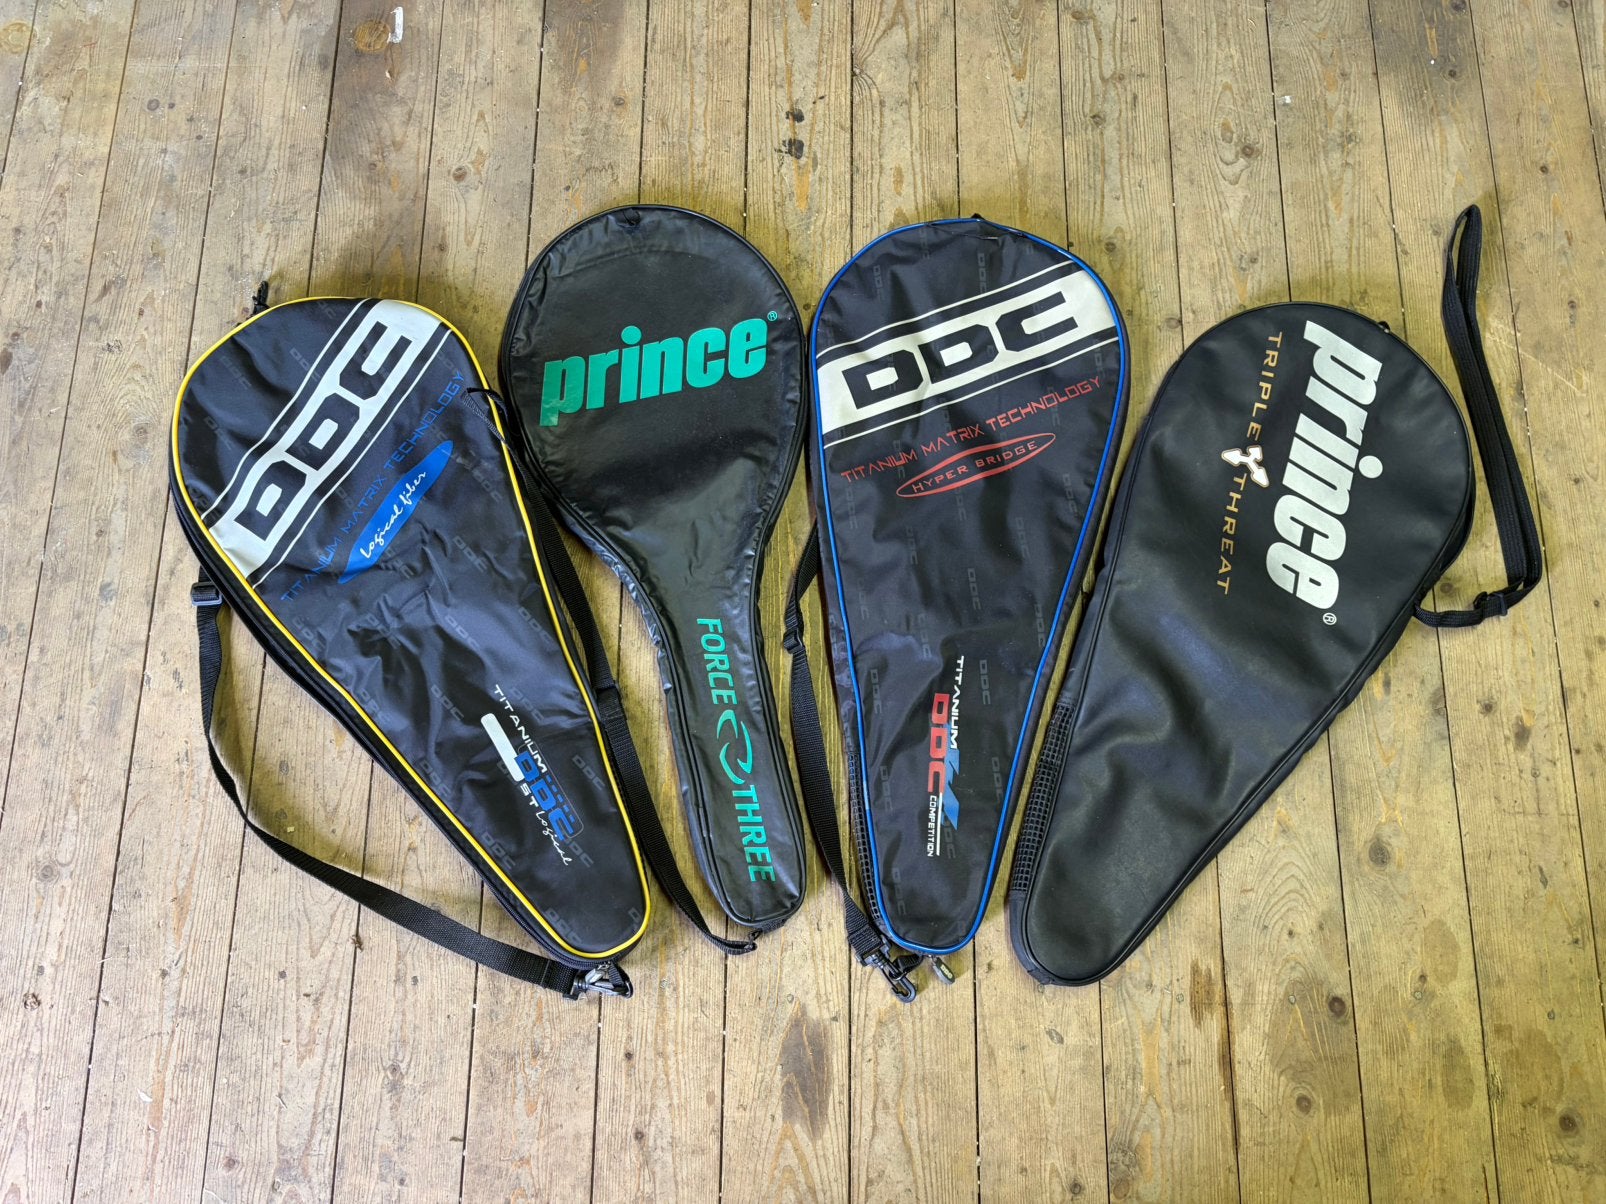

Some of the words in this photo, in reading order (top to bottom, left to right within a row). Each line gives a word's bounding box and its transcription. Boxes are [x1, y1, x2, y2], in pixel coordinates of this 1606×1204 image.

[842, 290, 1078, 410] DDC
[1246, 331, 1283, 442] TRIPLE
[234, 320, 412, 541] DDC
[280, 535, 344, 602] TITANIUM
[341, 474, 387, 534] MATRIX
[384, 367, 465, 472] TECHNOLOGY
[841, 448, 918, 484] TITANIUM
[920, 423, 985, 457] MATRIX
[986, 375, 1105, 432] TECHNOLOGY
[911, 464, 970, 494] HYPER
[975, 440, 1038, 468] BRIDGE
[1215, 472, 1247, 595] THREAT
[494, 683, 549, 773] TITANIUM
[696, 617, 738, 705] FORCE
[731, 784, 776, 883] THREE
[927, 692, 950, 794] DDC
[949, 654, 965, 750] TITANIUM
[926, 794, 938, 858] COMPETITION
